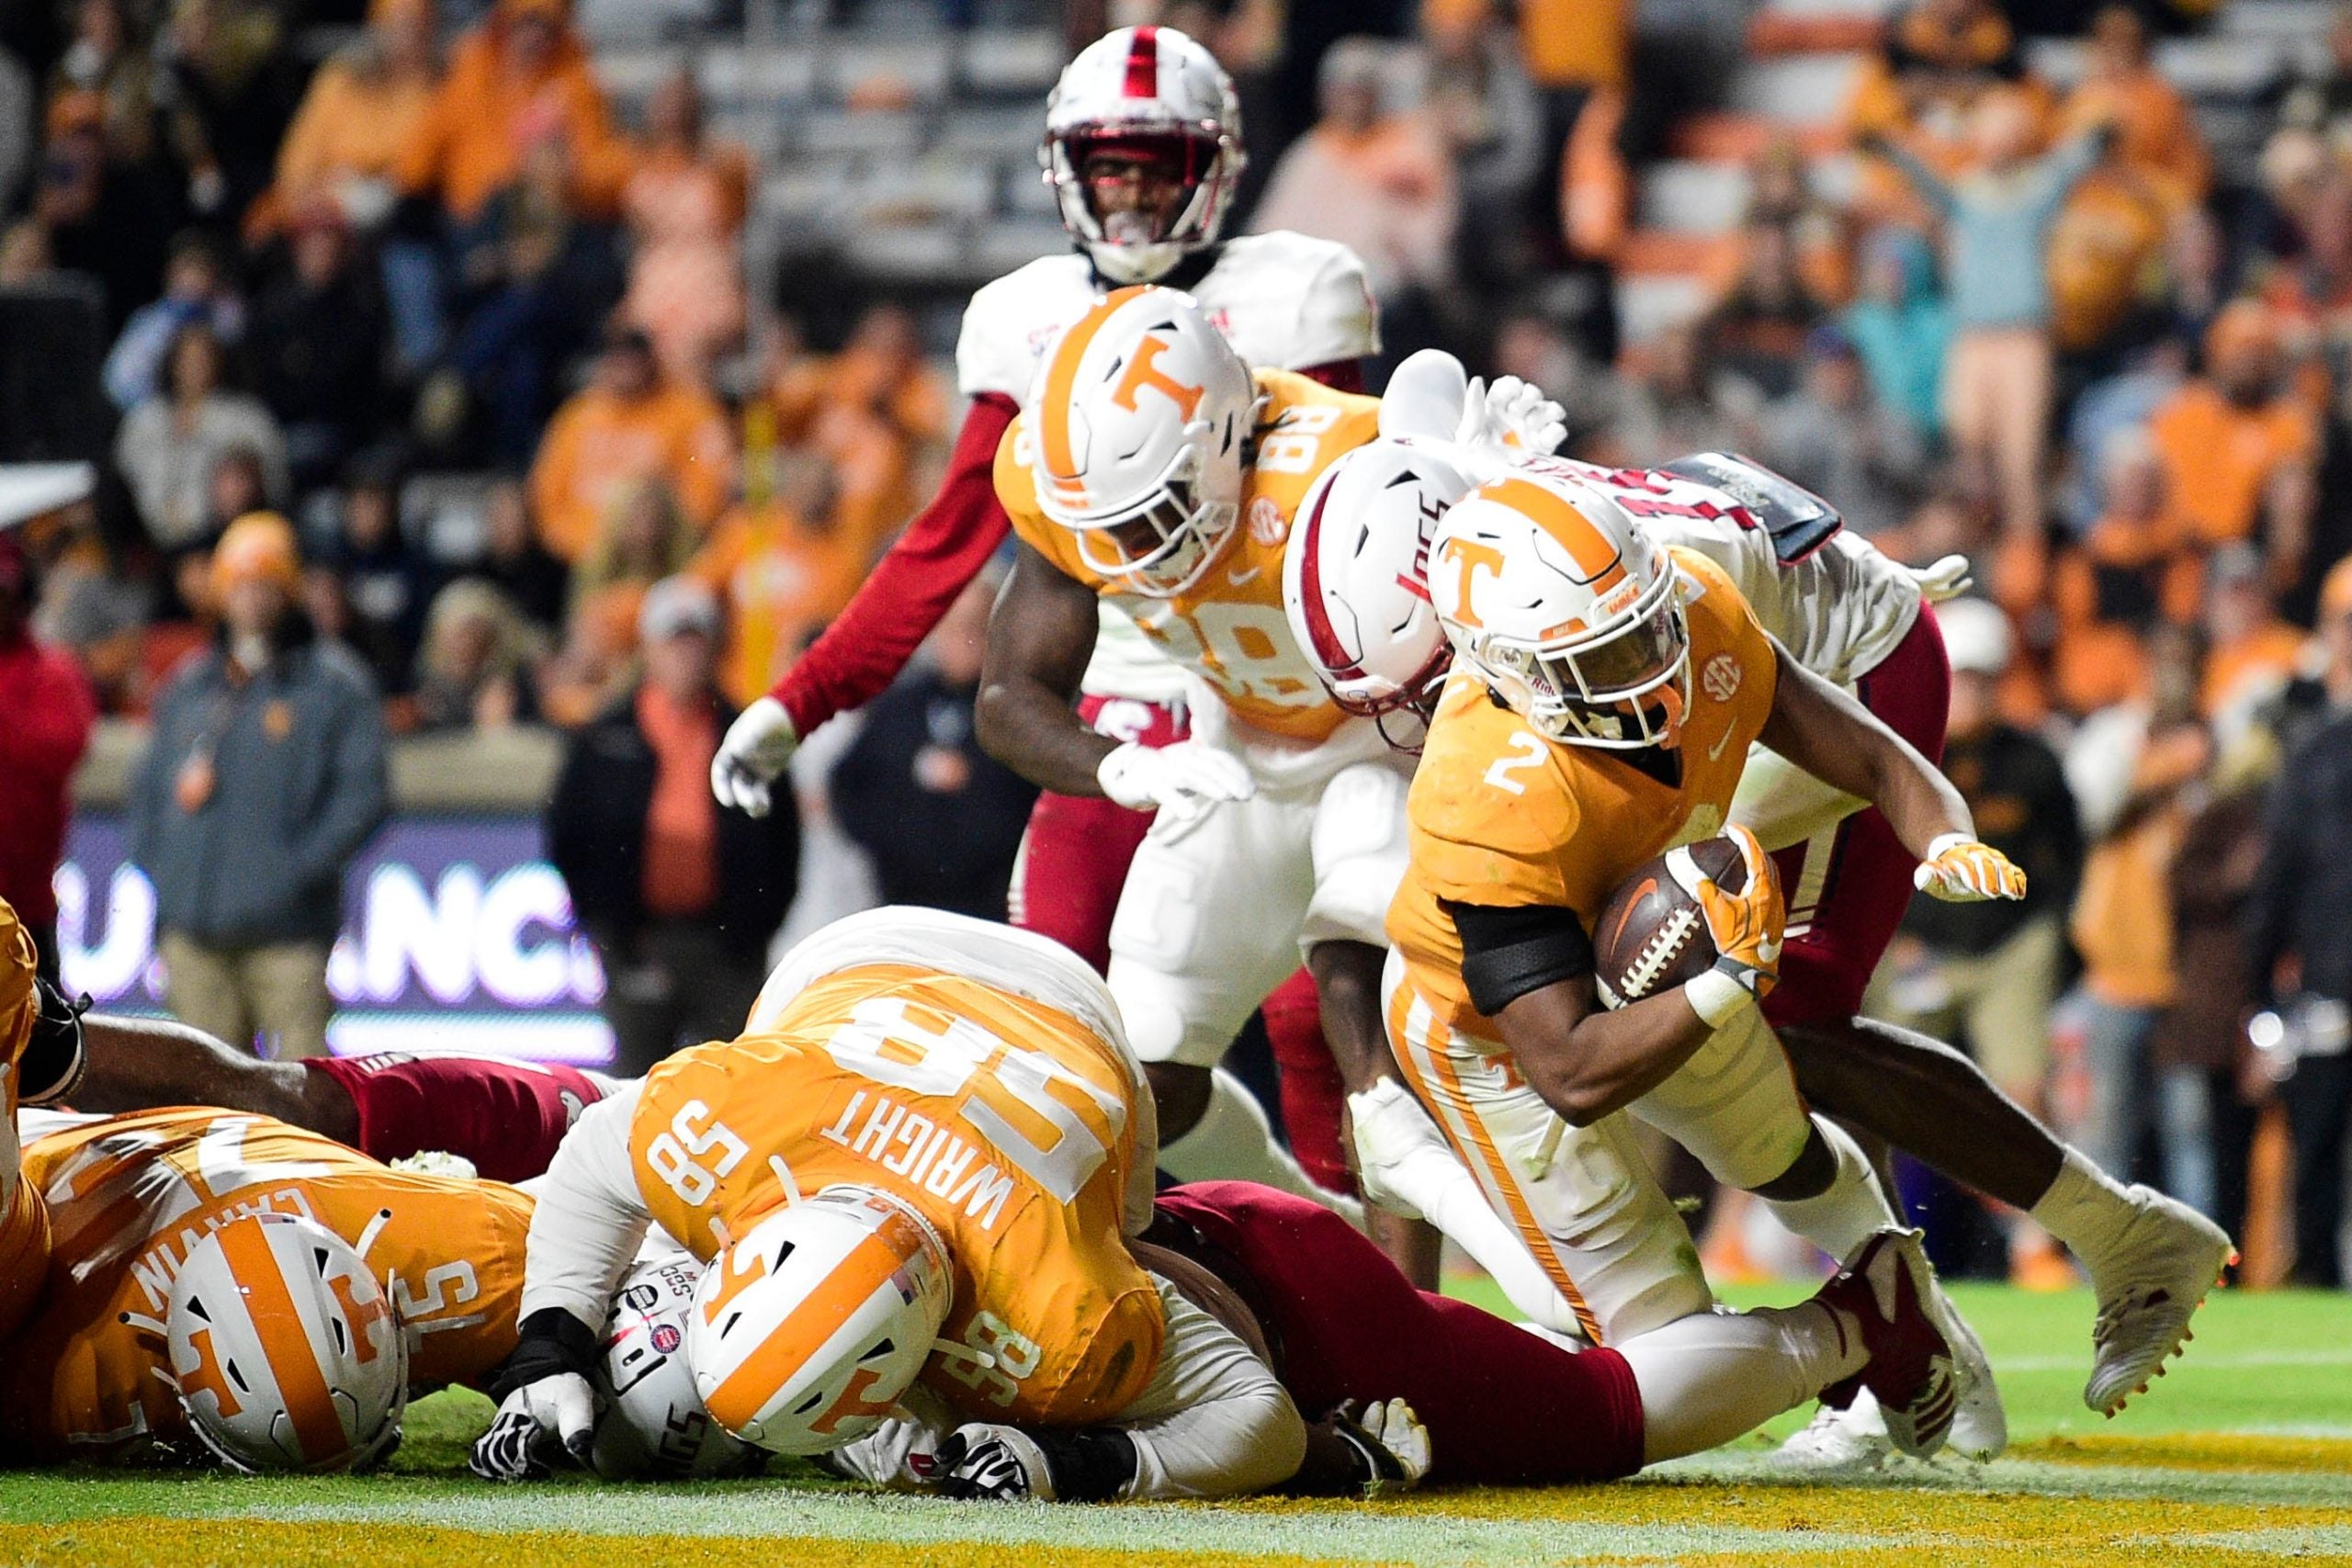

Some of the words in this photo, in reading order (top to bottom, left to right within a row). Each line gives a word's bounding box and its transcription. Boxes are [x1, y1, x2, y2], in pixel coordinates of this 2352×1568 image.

[1112, 333, 1204, 423] T
[1255, 402, 1343, 476] 88
[1442, 536, 1505, 628] T
[1703, 654, 1742, 702] SEC
[1483, 730, 1550, 796] 2
[646, 1100, 751, 1207] 58
[820, 1089, 1016, 1232] WRIGHT
[178, 1328, 243, 1418] T
